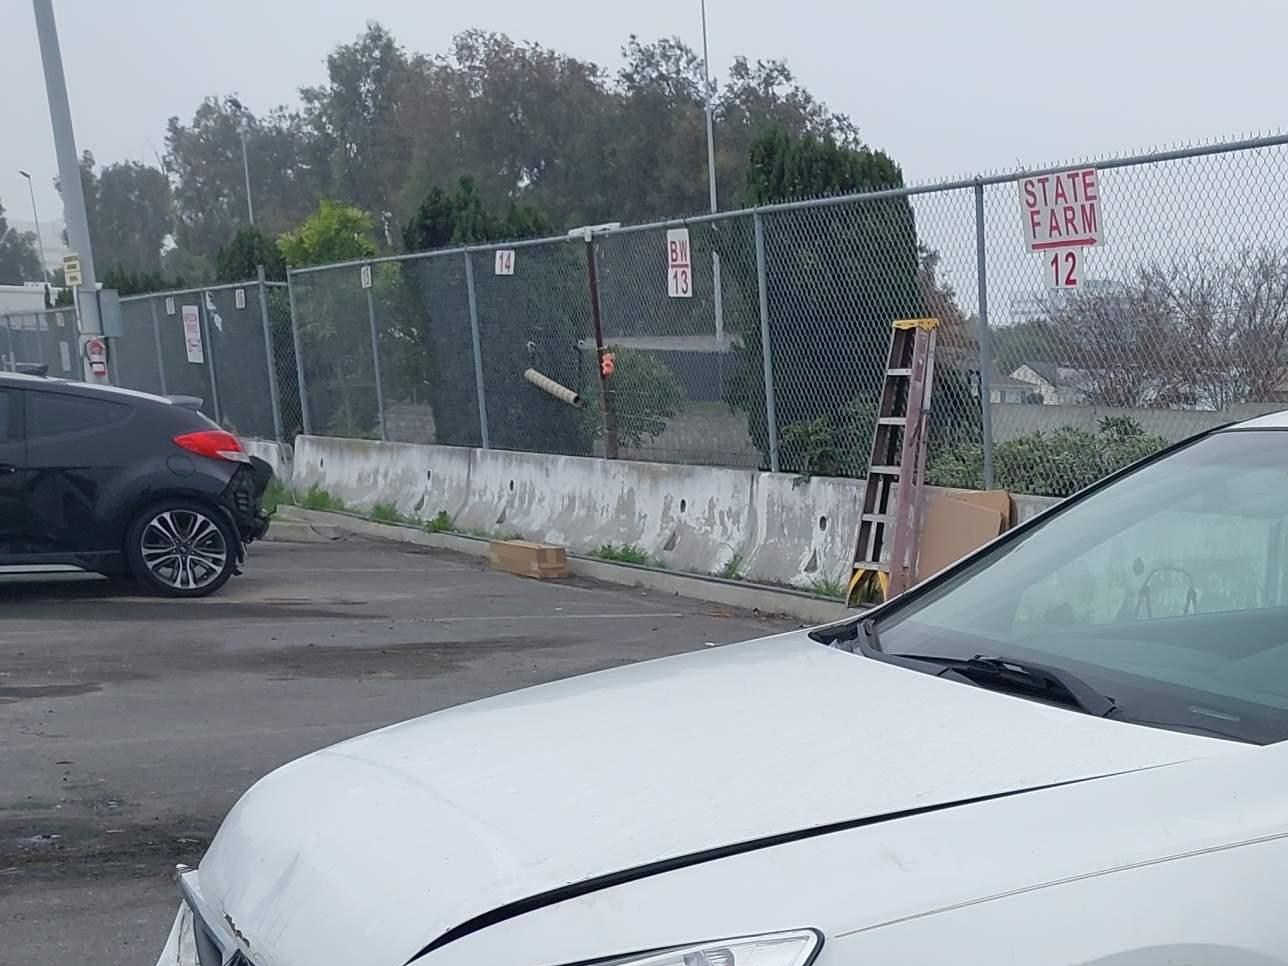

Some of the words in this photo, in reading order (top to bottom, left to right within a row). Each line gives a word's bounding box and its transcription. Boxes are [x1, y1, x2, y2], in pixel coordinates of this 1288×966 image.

[1024, 170, 1097, 208] STATE
[1030, 203, 1097, 239] FARM
[499, 251, 511, 272] 14
[670, 240, 688, 262] BW
[673, 270, 688, 294] 13
[1051, 252, 1077, 286] 12
